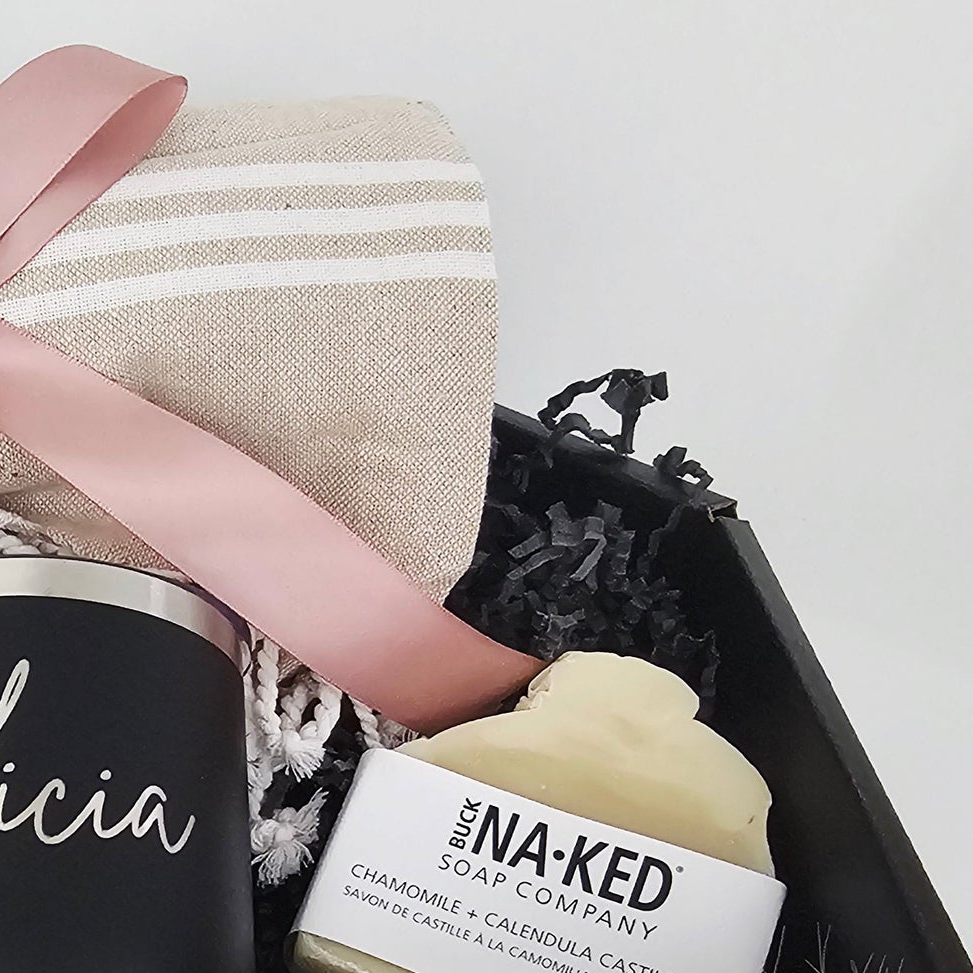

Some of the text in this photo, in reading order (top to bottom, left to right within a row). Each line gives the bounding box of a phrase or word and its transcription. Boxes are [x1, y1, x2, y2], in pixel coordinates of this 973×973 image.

[448, 798, 482, 850] BUCK
[343, 885, 389, 910] SAVON
[391, 903, 410, 918] DE
[412, 912, 472, 940] CASTILLE
[487, 938, 504, 953] LA
[350, 863, 462, 915] CHAMOMILE
[467, 909, 478, 920] +
[484, 912, 592, 962] CALENDULA
[438, 853, 658, 941] SOAP COMPANY
